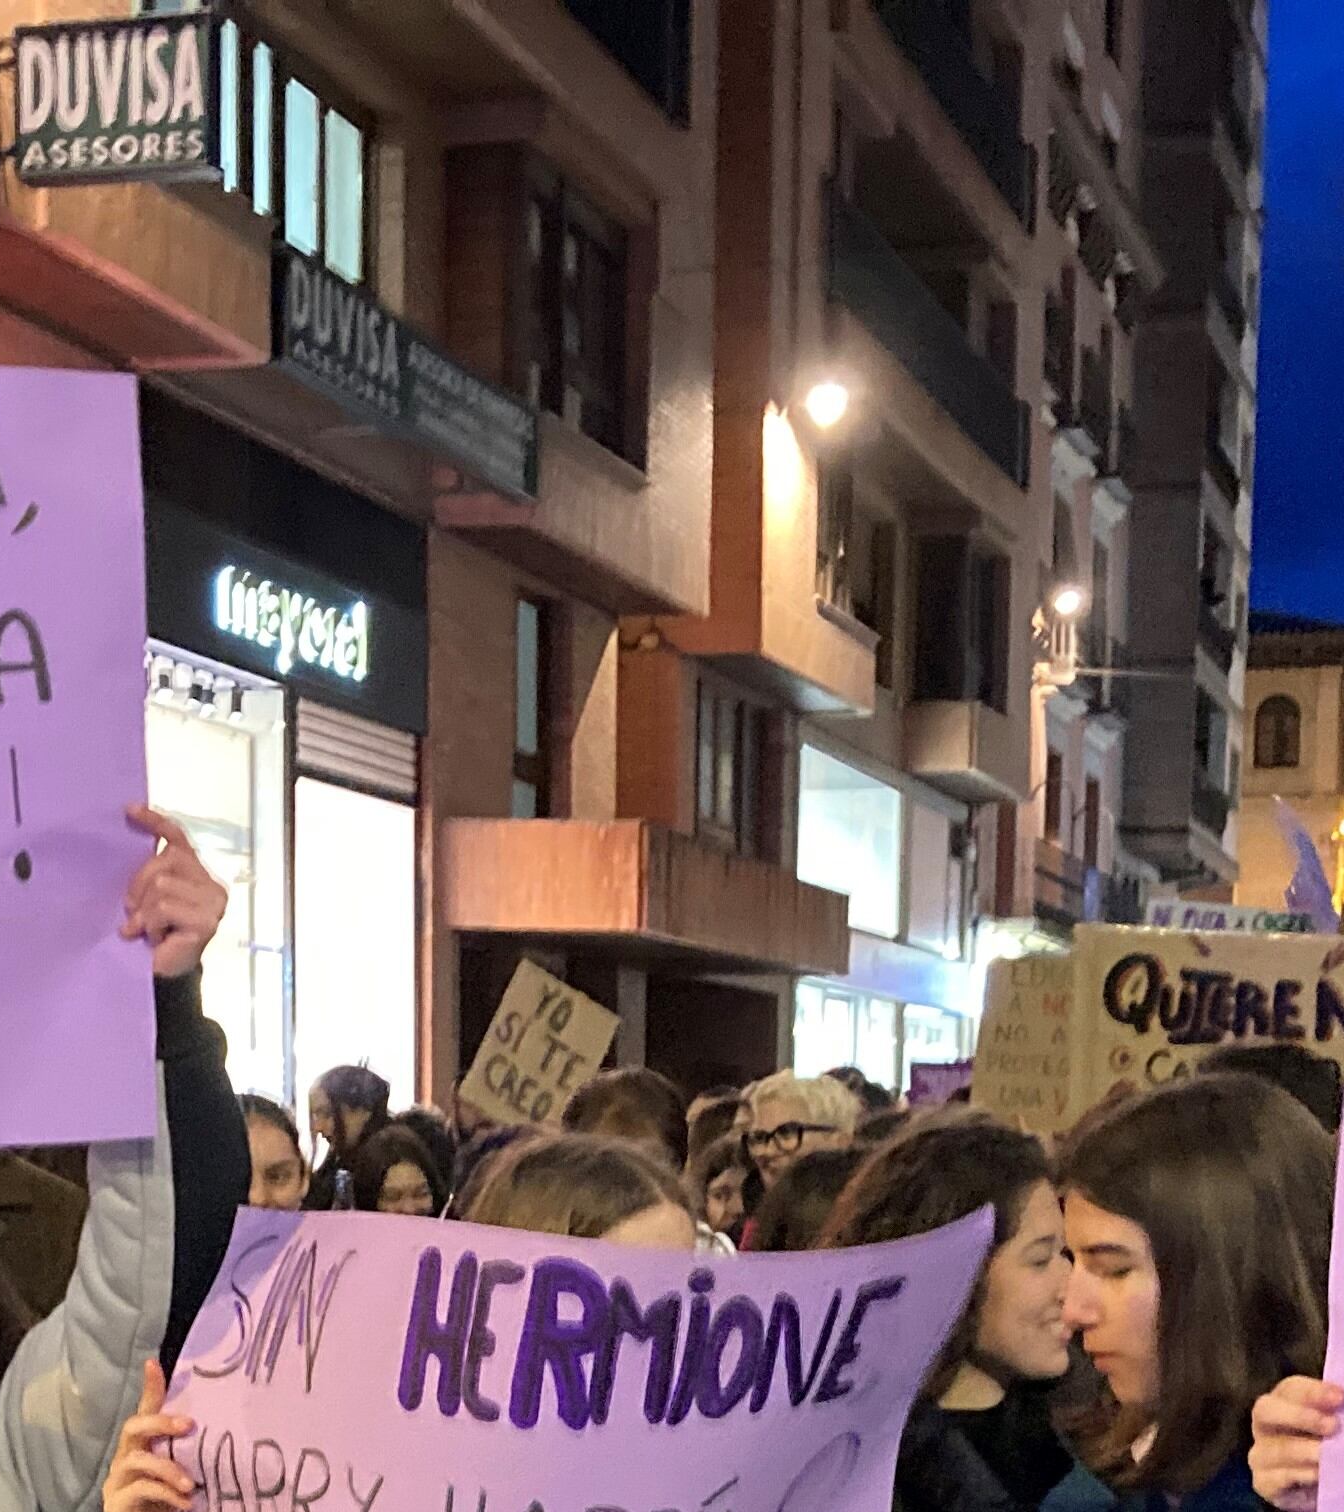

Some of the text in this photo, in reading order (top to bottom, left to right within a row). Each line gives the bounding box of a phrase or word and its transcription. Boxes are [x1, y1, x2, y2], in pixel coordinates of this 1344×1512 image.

[18, 24, 206, 135] DUVISA
[20, 129, 206, 172] ASESORES
[289, 254, 401, 390] DUVISA
[534, 983, 576, 1034] YO
[539, 1033, 587, 1091] TE
[1144, 1049, 1191, 1084] CA
[192, 1235, 356, 1395] SIN
